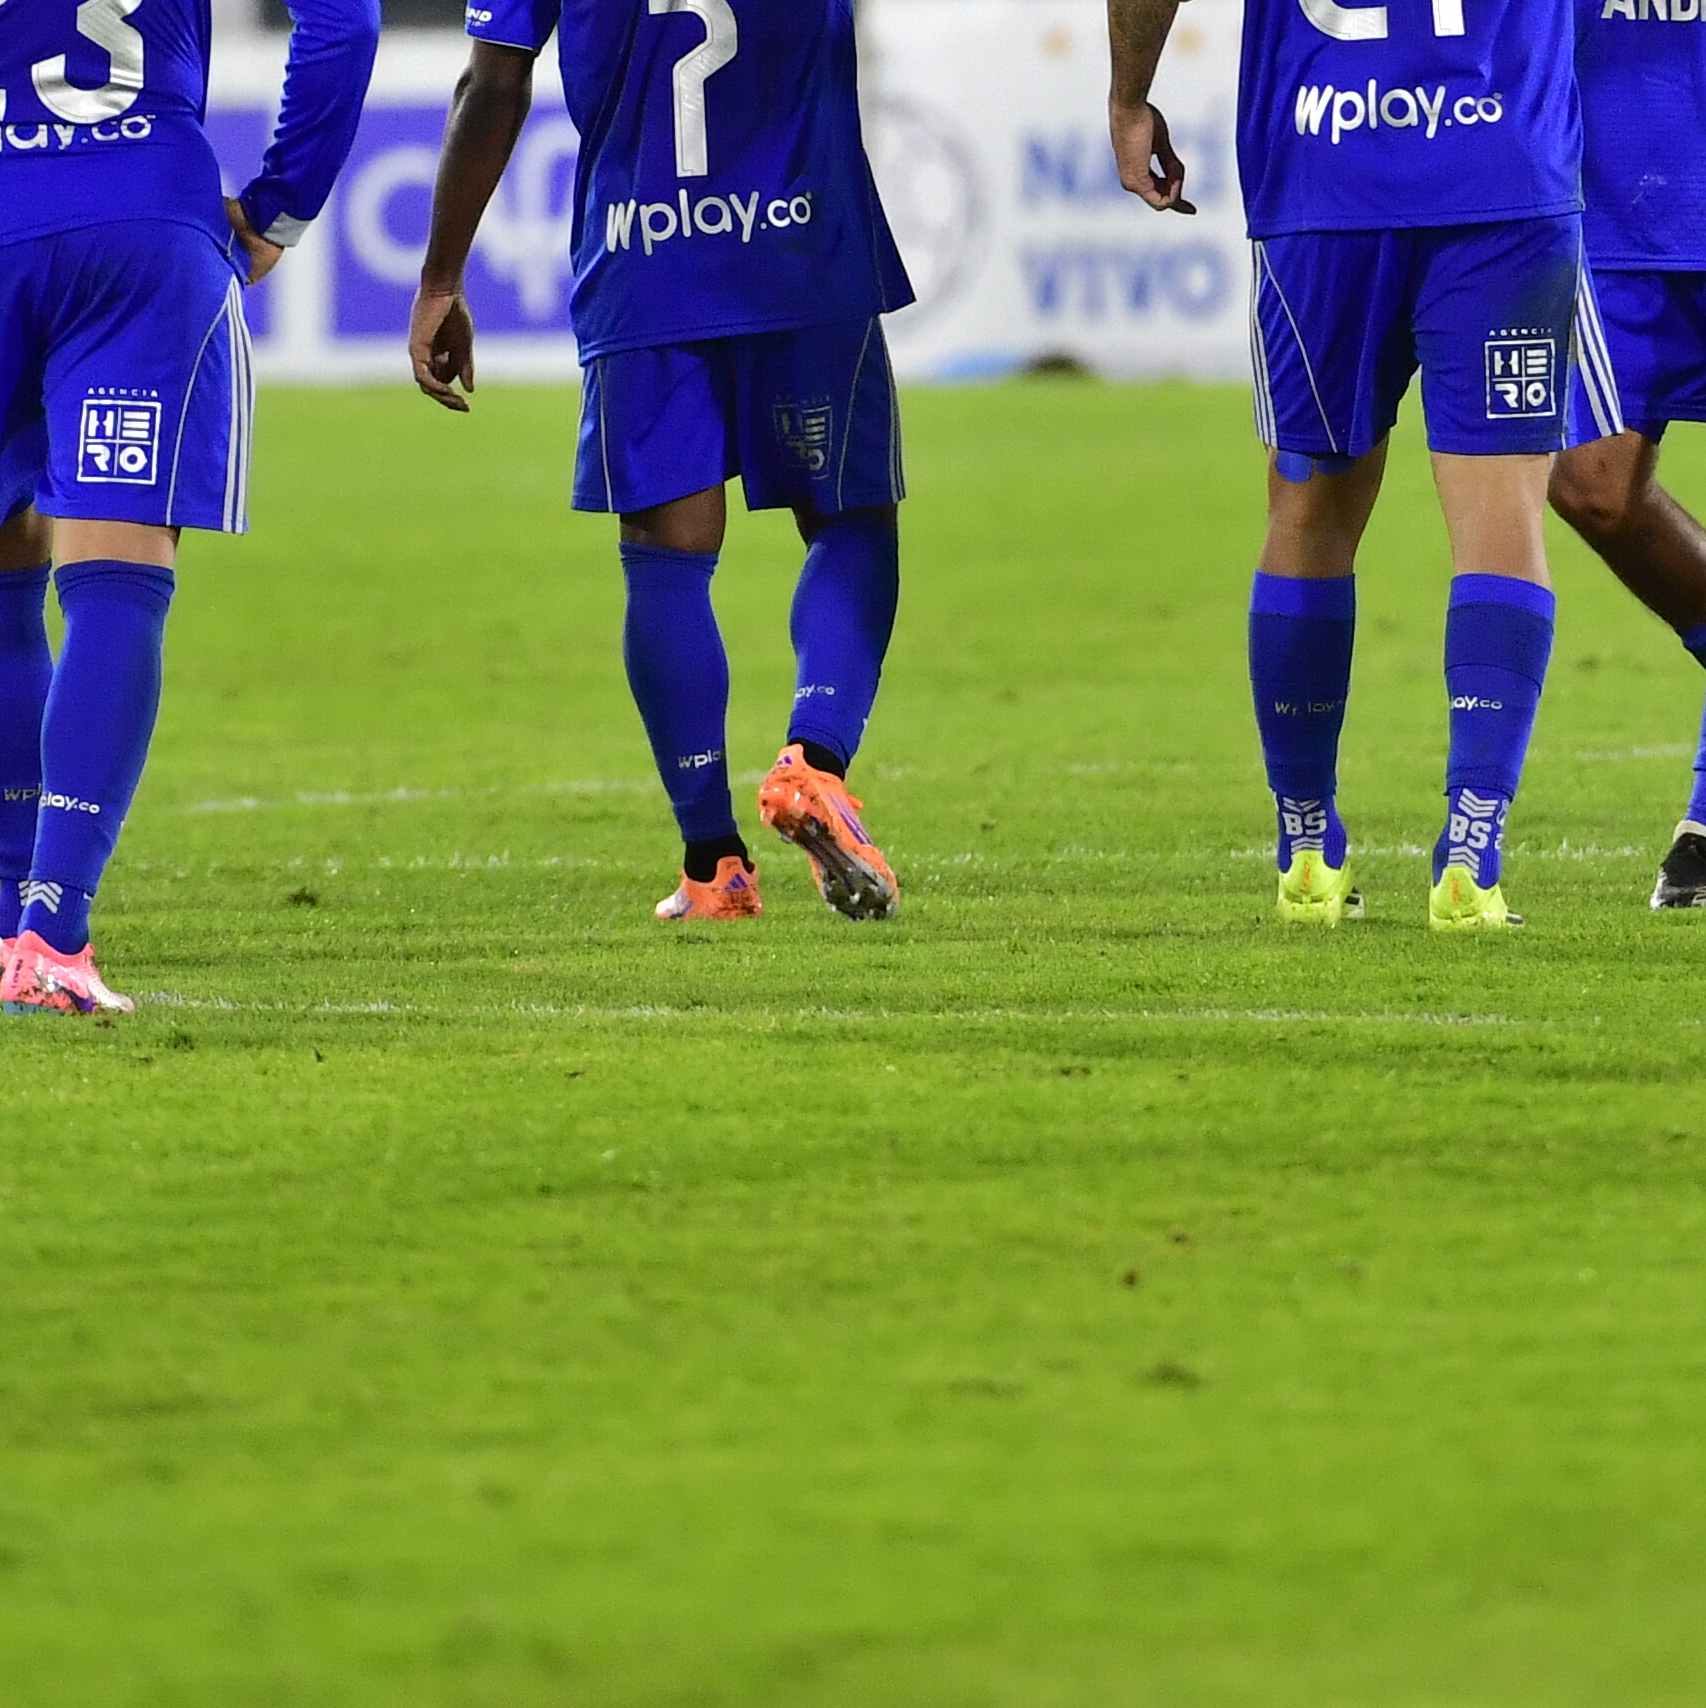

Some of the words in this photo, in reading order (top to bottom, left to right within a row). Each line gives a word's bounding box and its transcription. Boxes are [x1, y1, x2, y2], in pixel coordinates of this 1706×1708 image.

[87, 387, 159, 398] AGENCIA
[1282, 809, 1328, 836] BS
[1449, 812, 1493, 849] BS
